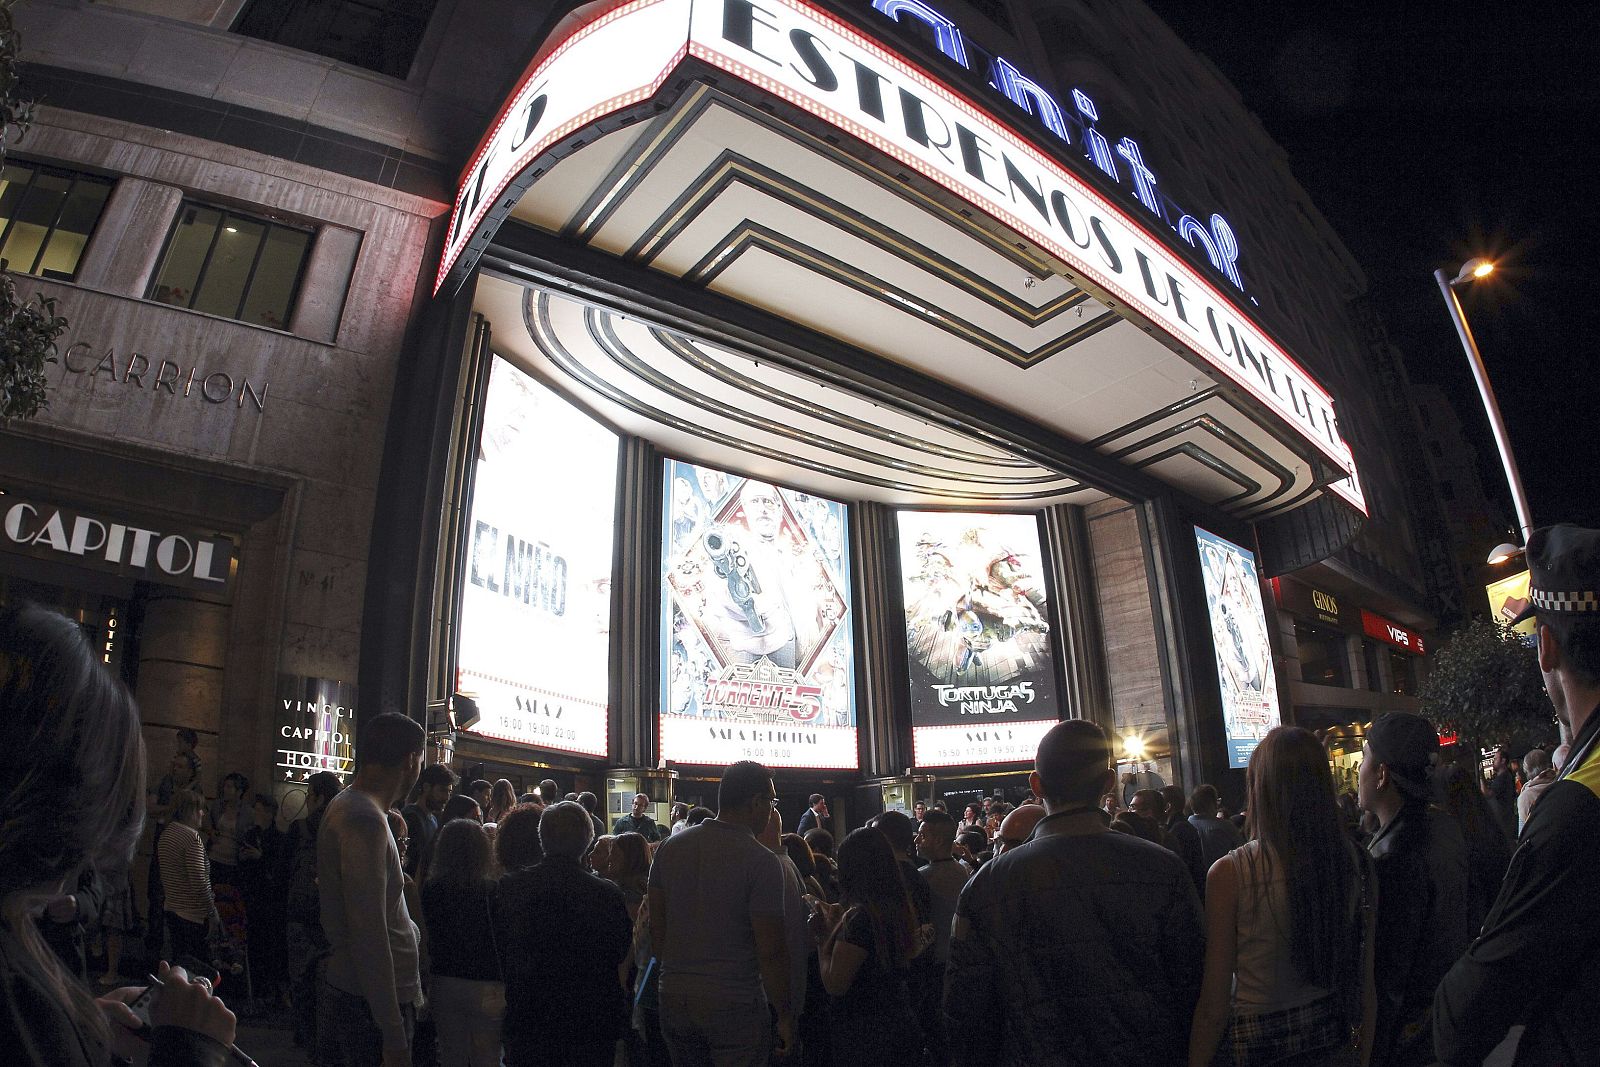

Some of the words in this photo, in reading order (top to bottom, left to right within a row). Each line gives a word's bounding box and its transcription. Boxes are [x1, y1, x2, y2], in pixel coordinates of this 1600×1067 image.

[722, 0, 1123, 274] ESTRENOS
[1135, 248, 1199, 333] DE
[1206, 306, 1284, 402] CINE
[63, 341, 269, 414] CARRION
[4, 502, 226, 583] CAPITOL
[1386, 624, 1409, 646] VIPS
[705, 678, 793, 709] TORRENTE
[788, 684, 822, 722] 5
[931, 681, 1036, 707] TORTUGAS
[283, 699, 354, 720] VINCCI
[960, 699, 1019, 716] NINJA
[281, 725, 352, 746] CAPITOL
[286, 752, 345, 771] HOTEL
